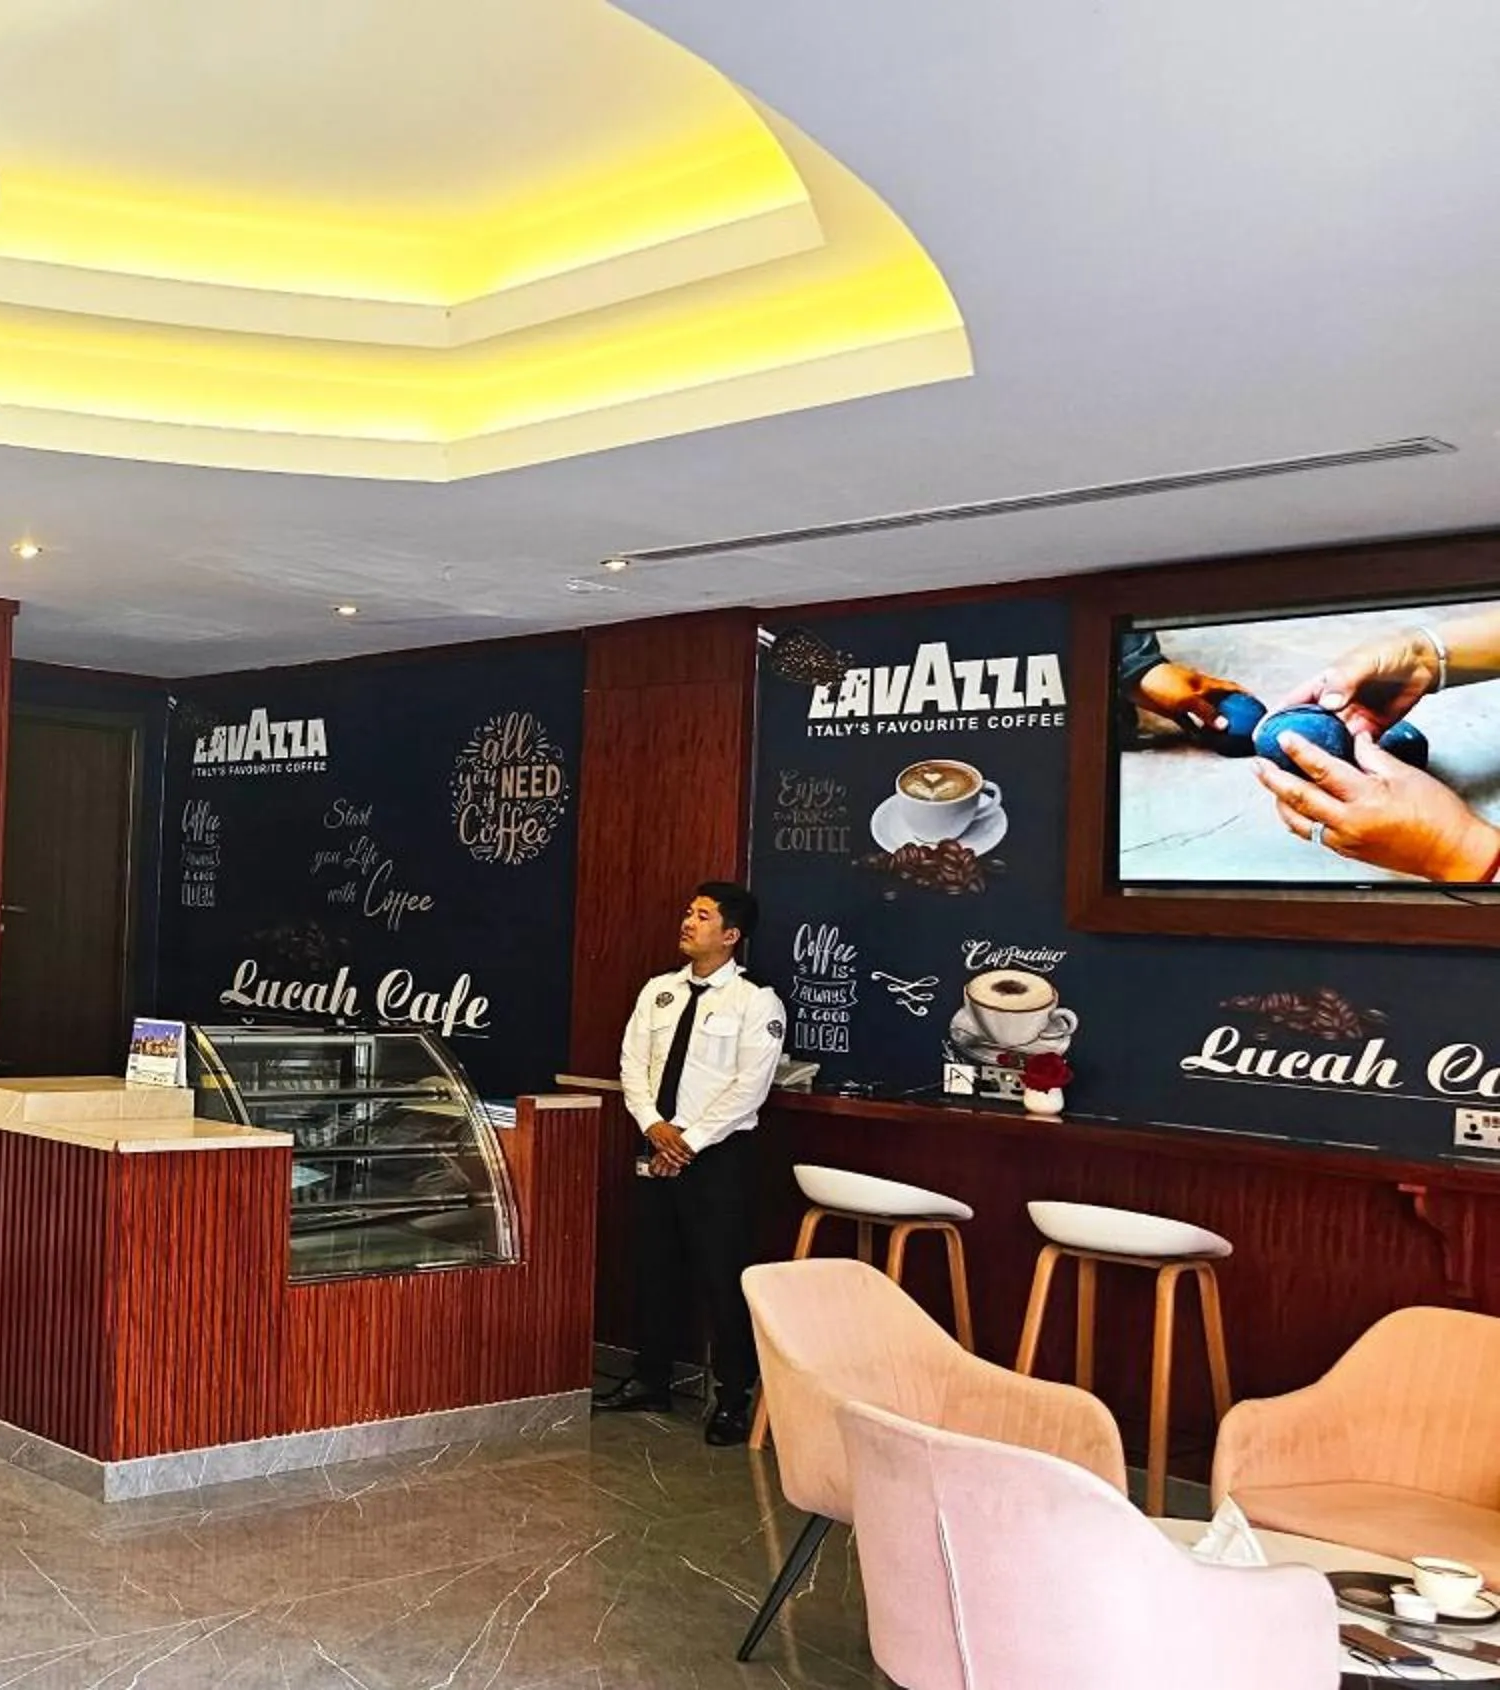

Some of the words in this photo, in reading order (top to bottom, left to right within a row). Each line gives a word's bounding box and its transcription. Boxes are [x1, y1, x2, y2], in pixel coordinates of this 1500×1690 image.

[808, 642, 1067, 719] LAVAZZA
[193, 707, 328, 764] LAVAZZA
[482, 711, 533, 766] all
[807, 722, 870, 737] ITALY'S
[877, 717, 978, 735] FAVOURITE
[987, 713, 1066, 729] COFFEE
[228, 763, 282, 776] FAVOURITE
[285, 761, 328, 773] COFFEE
[458, 767, 499, 805] you
[501, 763, 561, 800] NEED
[778, 769, 835, 808] Enjoy
[459, 802, 551, 864] Coffee
[363, 859, 436, 932] Coffee
[793, 923, 859, 975] Coffee
[219, 959, 361, 1016] Lucah
[376, 969, 491, 1038] Cafe
[798, 1007, 807, 1019] A
[811, 1010, 851, 1023] GOOD
[799, 985, 848, 1004] ALWAYS
[1179, 1025, 1404, 1089] Lucah
[1426, 1043, 1500, 1097] Ca
